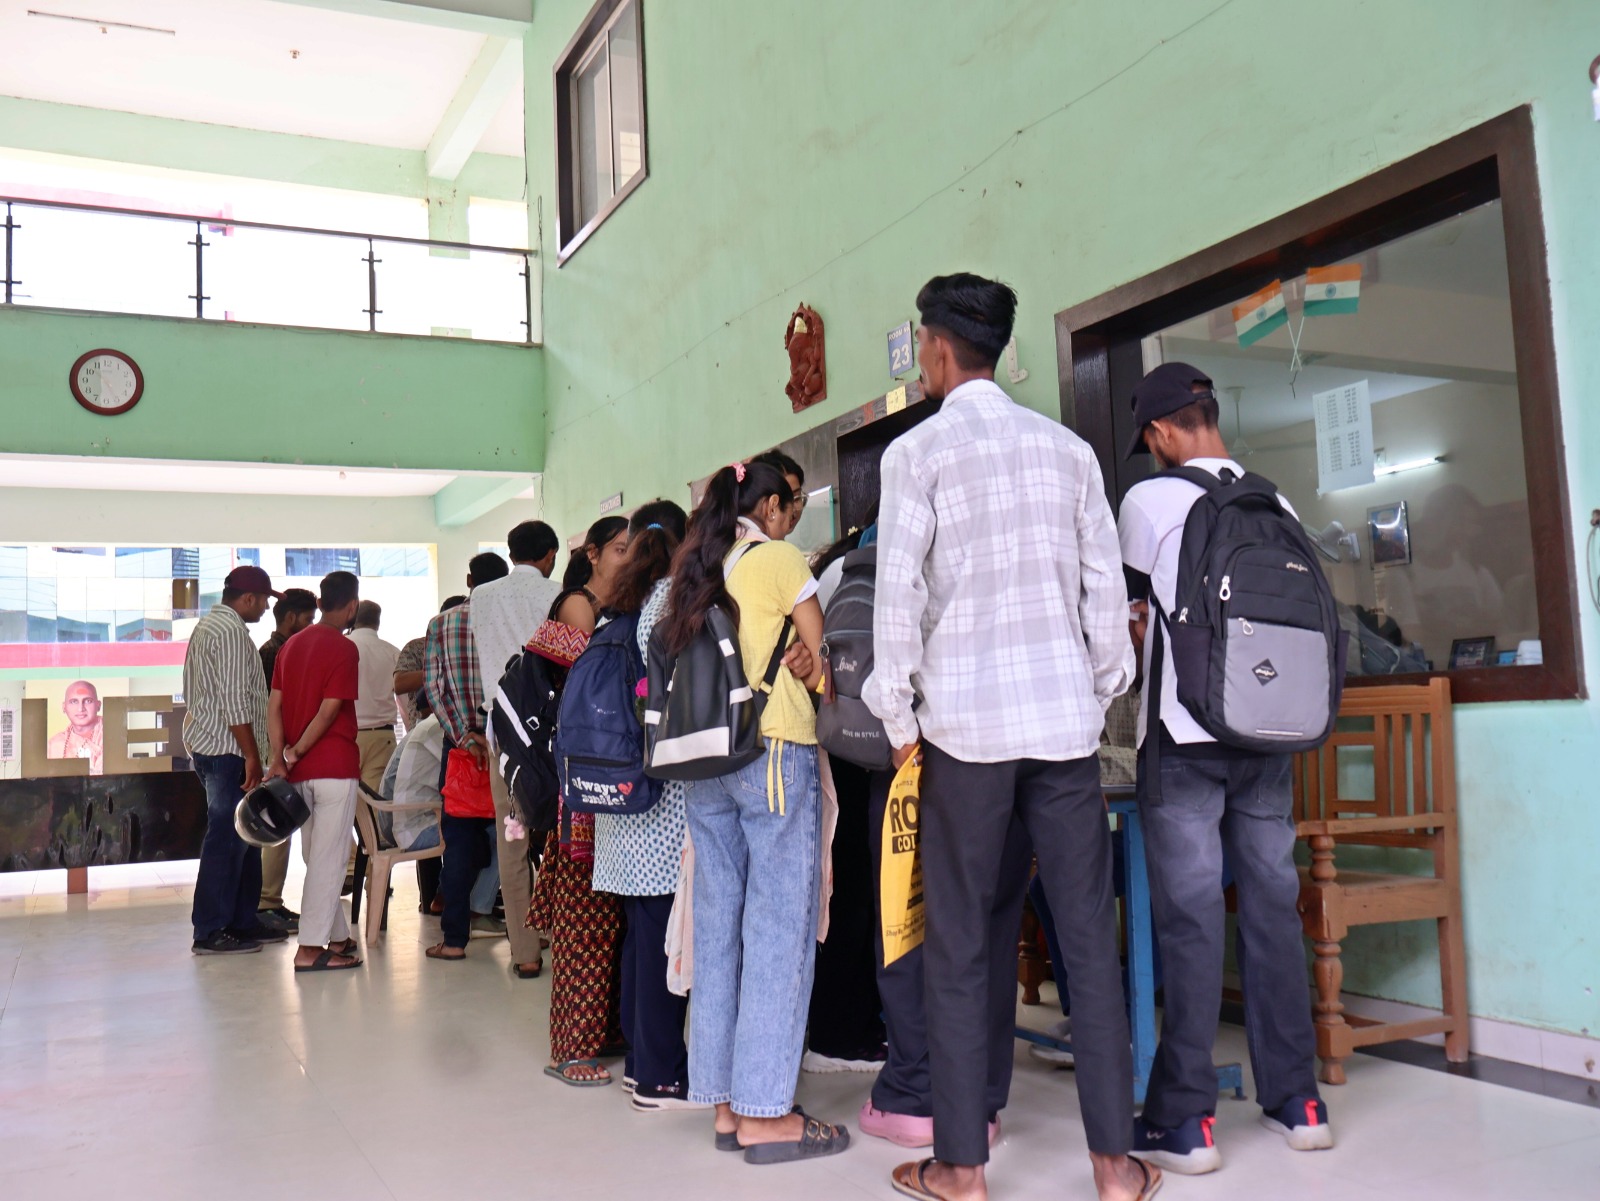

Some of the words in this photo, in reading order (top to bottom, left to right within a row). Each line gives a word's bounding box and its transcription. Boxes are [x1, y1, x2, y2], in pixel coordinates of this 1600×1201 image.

[892, 343, 910, 371] 23
[86, 368, 94, 376] 10
[93, 394, 99, 402] 7
[21, 695, 193, 779] LE
[571, 777, 617, 796] always
